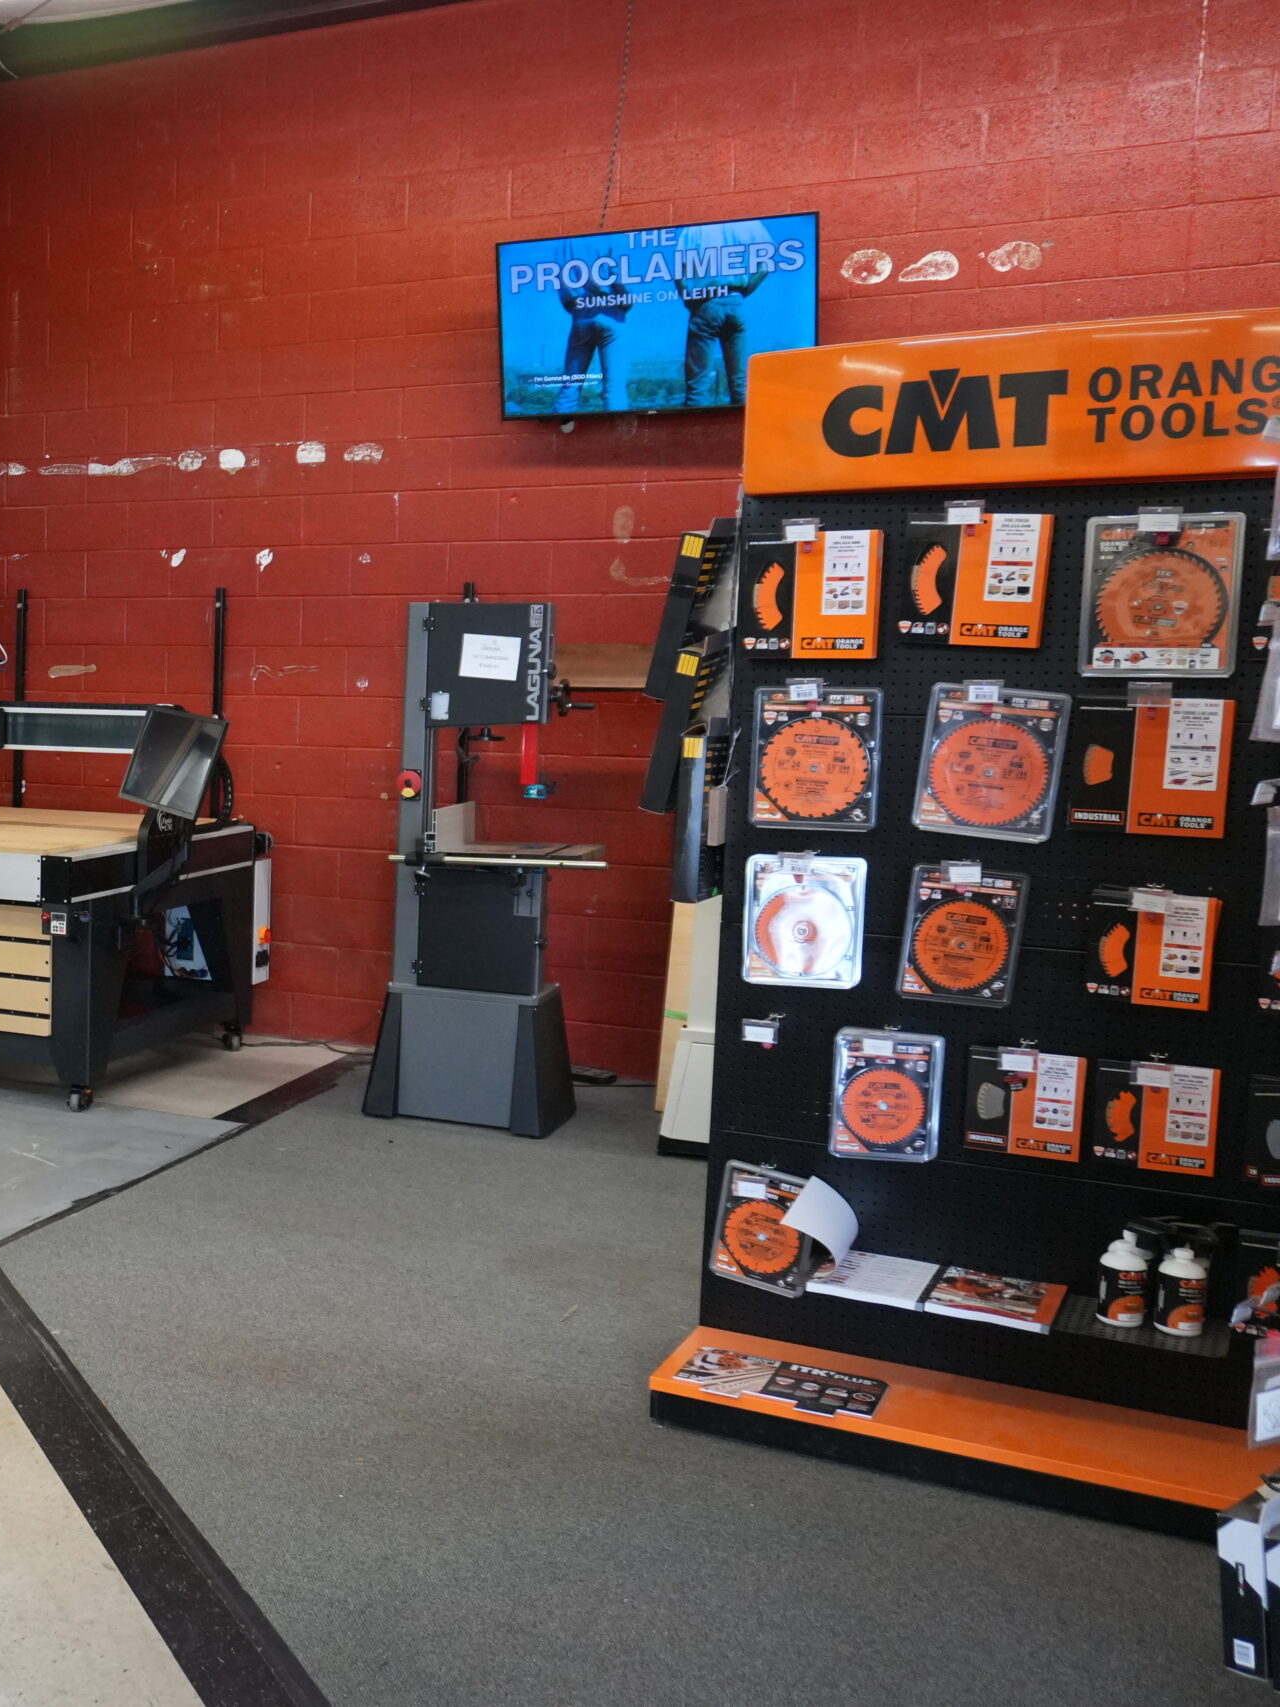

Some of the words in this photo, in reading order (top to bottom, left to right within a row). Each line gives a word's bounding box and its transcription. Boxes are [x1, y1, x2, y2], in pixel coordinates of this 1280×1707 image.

[624, 227, 677, 249] THE
[509, 239, 805, 294] PROCLAIMERS
[576, 292, 652, 309] SUNSHINE
[656, 290, 678, 302] ON
[683, 285, 729, 301] LEITH
[822, 368, 1069, 457] CMT
[1087, 355, 1280, 403] ORANG
[1087, 398, 1267, 443] TOOLS
[961, 623, 997, 637] CMT
[802, 637, 834, 650] CMT
[526, 627, 543, 720] LAGUNA
[1074, 811, 1121, 822] INDUSTRIAL
[1138, 813, 1178, 827] CMT
[1179, 816, 1213, 824] ORANGE
[1141, 988, 1173, 1001] CMT
[1016, 1139, 1046, 1151] CMT
[1147, 1153, 1178, 1166] CMT
[834, 1373, 871, 1385] PLUS
